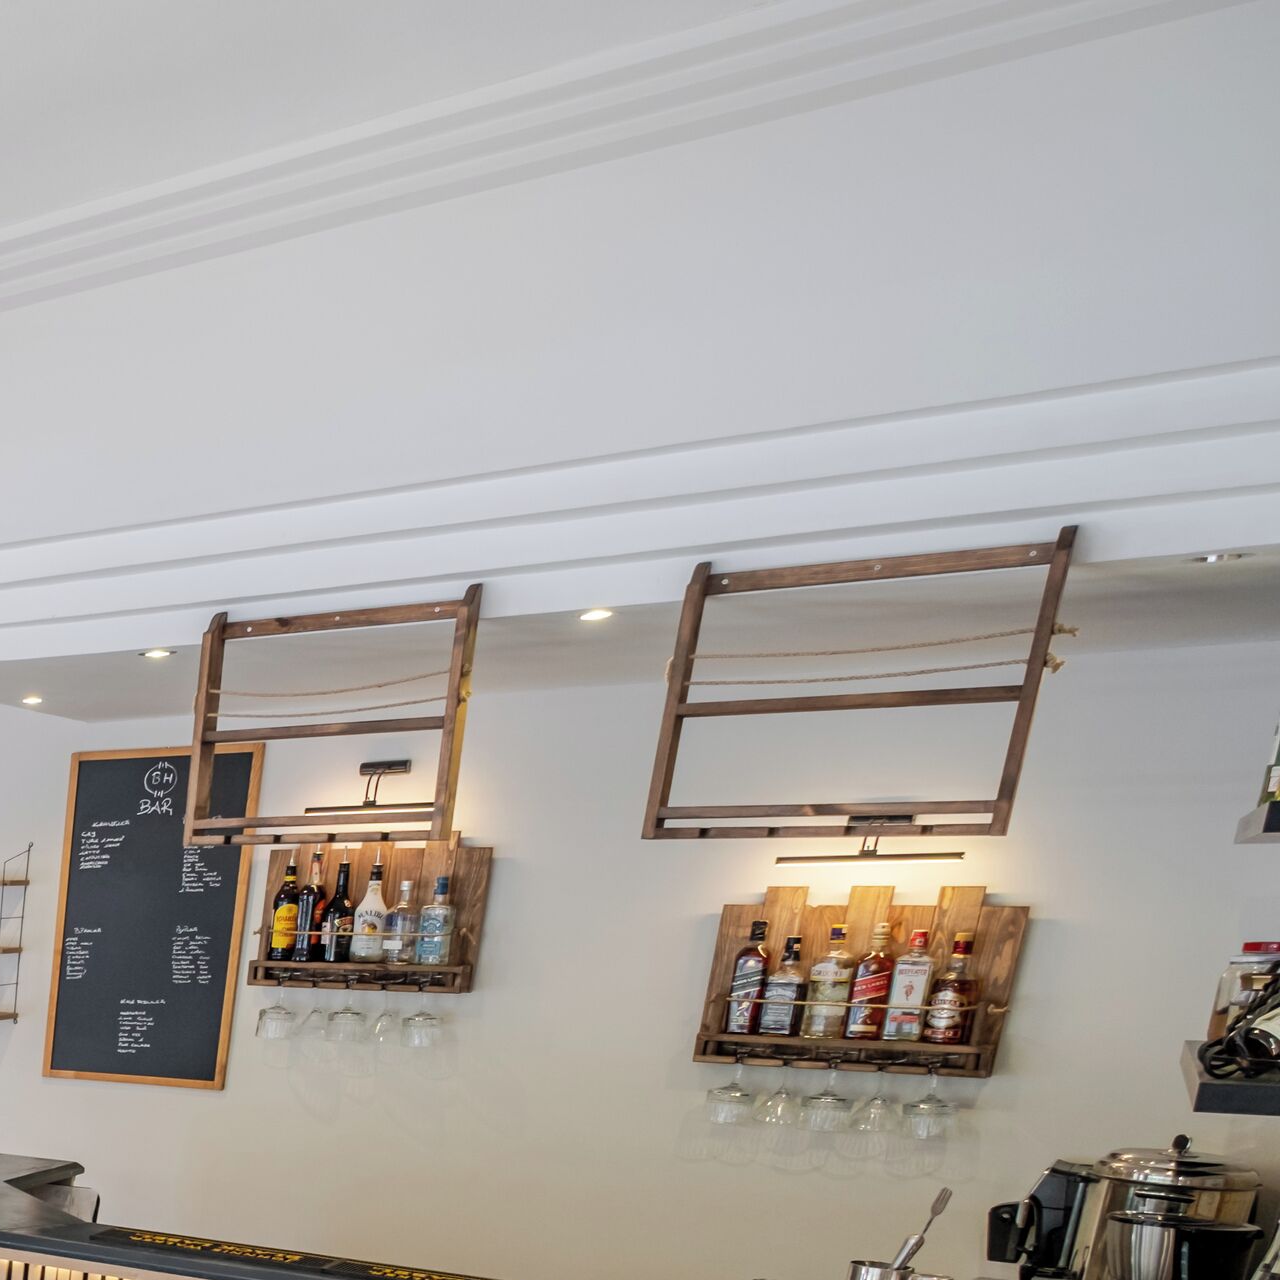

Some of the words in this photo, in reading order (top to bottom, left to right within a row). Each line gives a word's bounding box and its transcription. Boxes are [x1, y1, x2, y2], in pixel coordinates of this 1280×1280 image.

[151, 771, 173, 785] BH
[136, 797, 173, 816] BAR
[357, 908, 385, 920] MALIBU
[897, 968, 928, 977] BEEFEATER
[867, 979, 889, 988] LABEL
